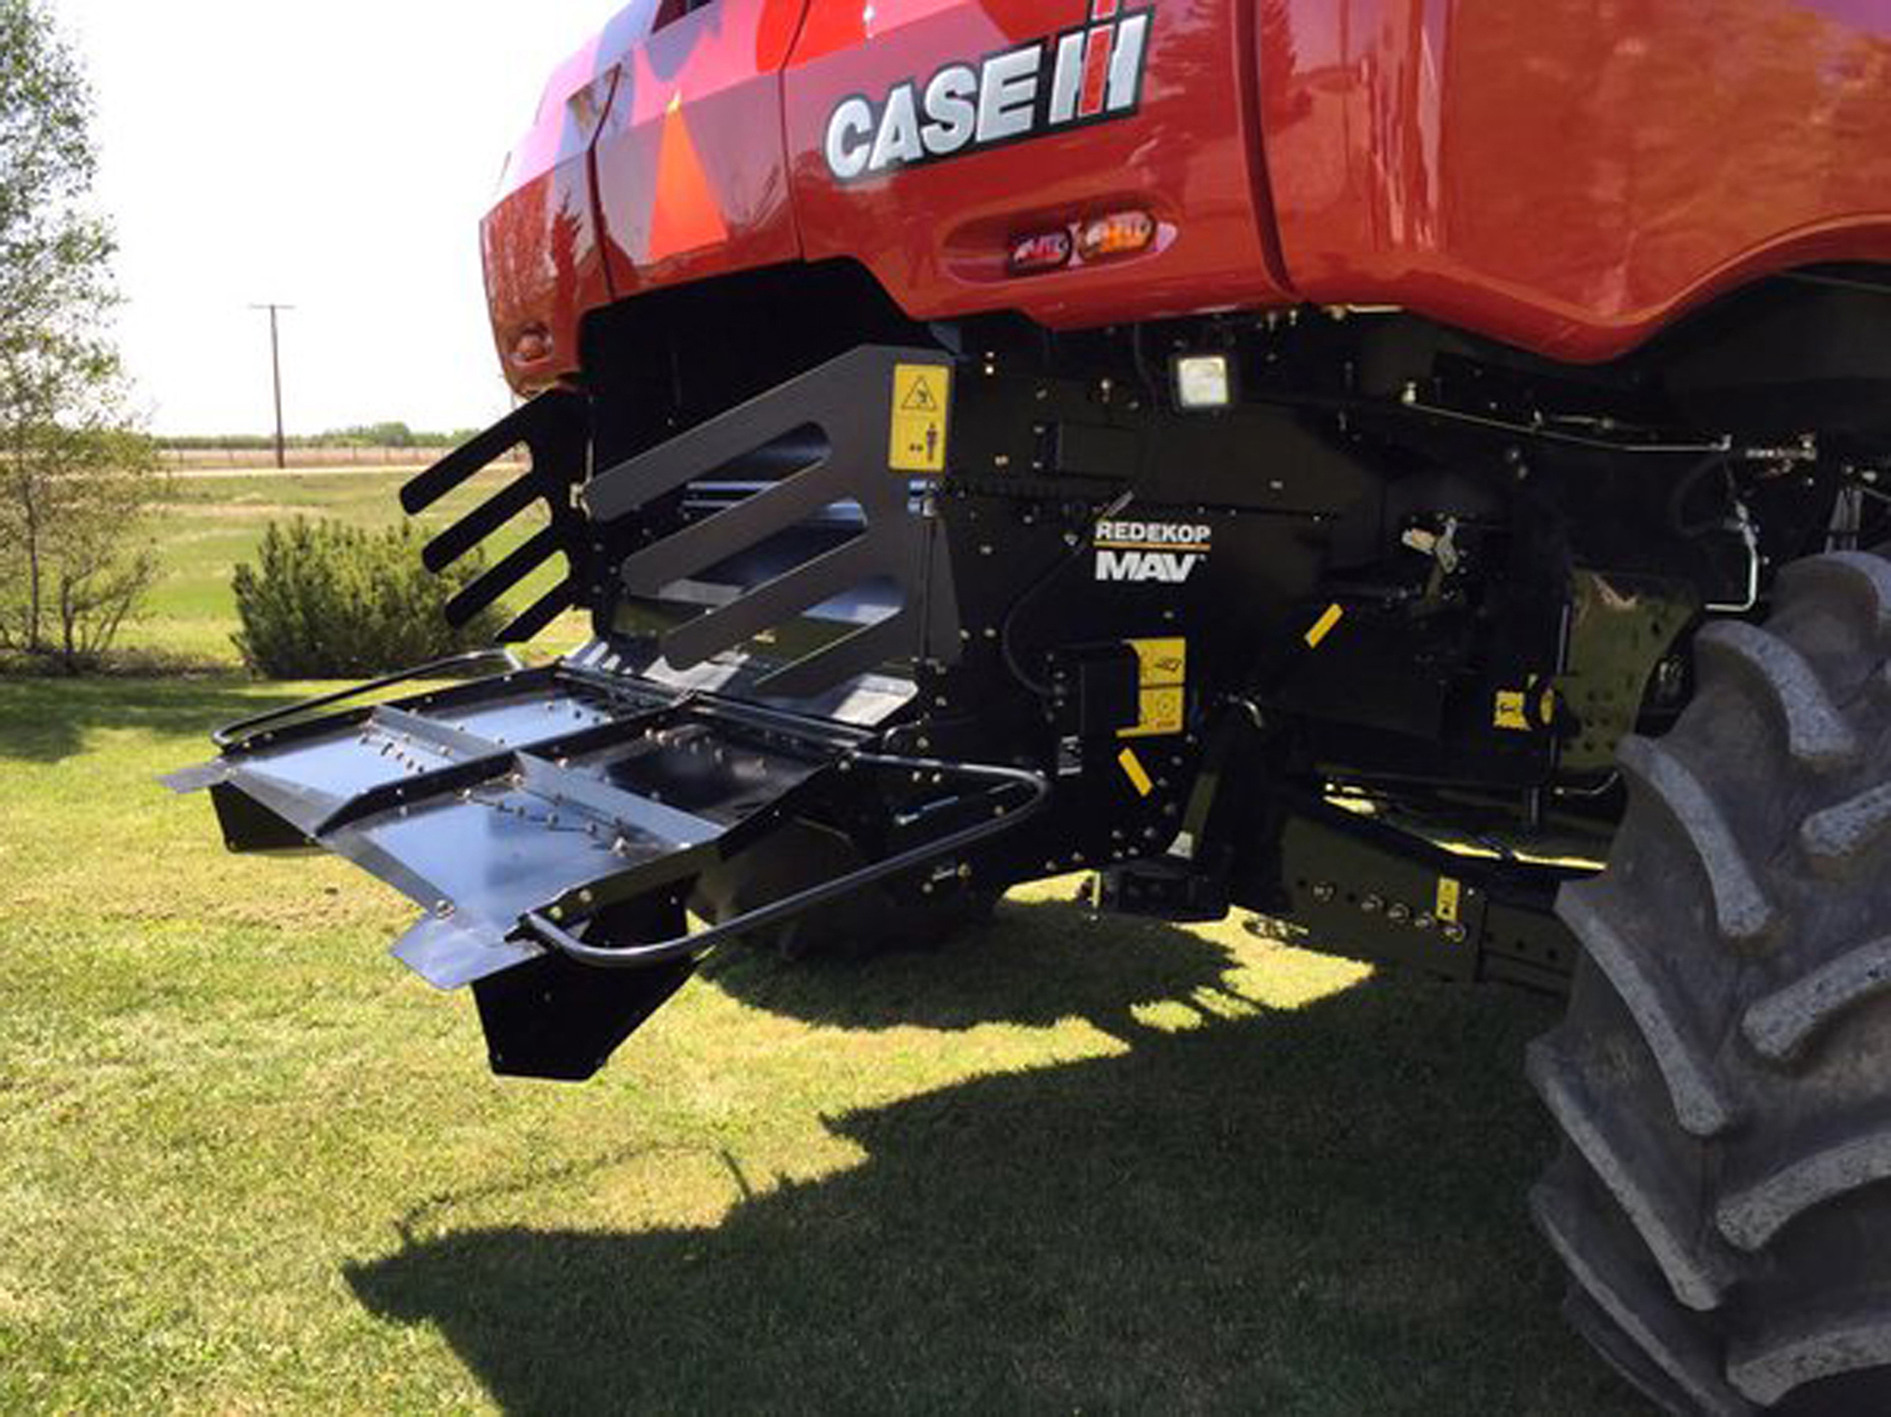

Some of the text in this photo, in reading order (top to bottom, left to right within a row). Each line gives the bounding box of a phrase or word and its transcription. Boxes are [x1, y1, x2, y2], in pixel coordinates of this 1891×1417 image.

[825, 44, 1043, 178] CASE
[1095, 521, 1211, 542] REDEKOP
[1095, 550, 1198, 582] MAV
